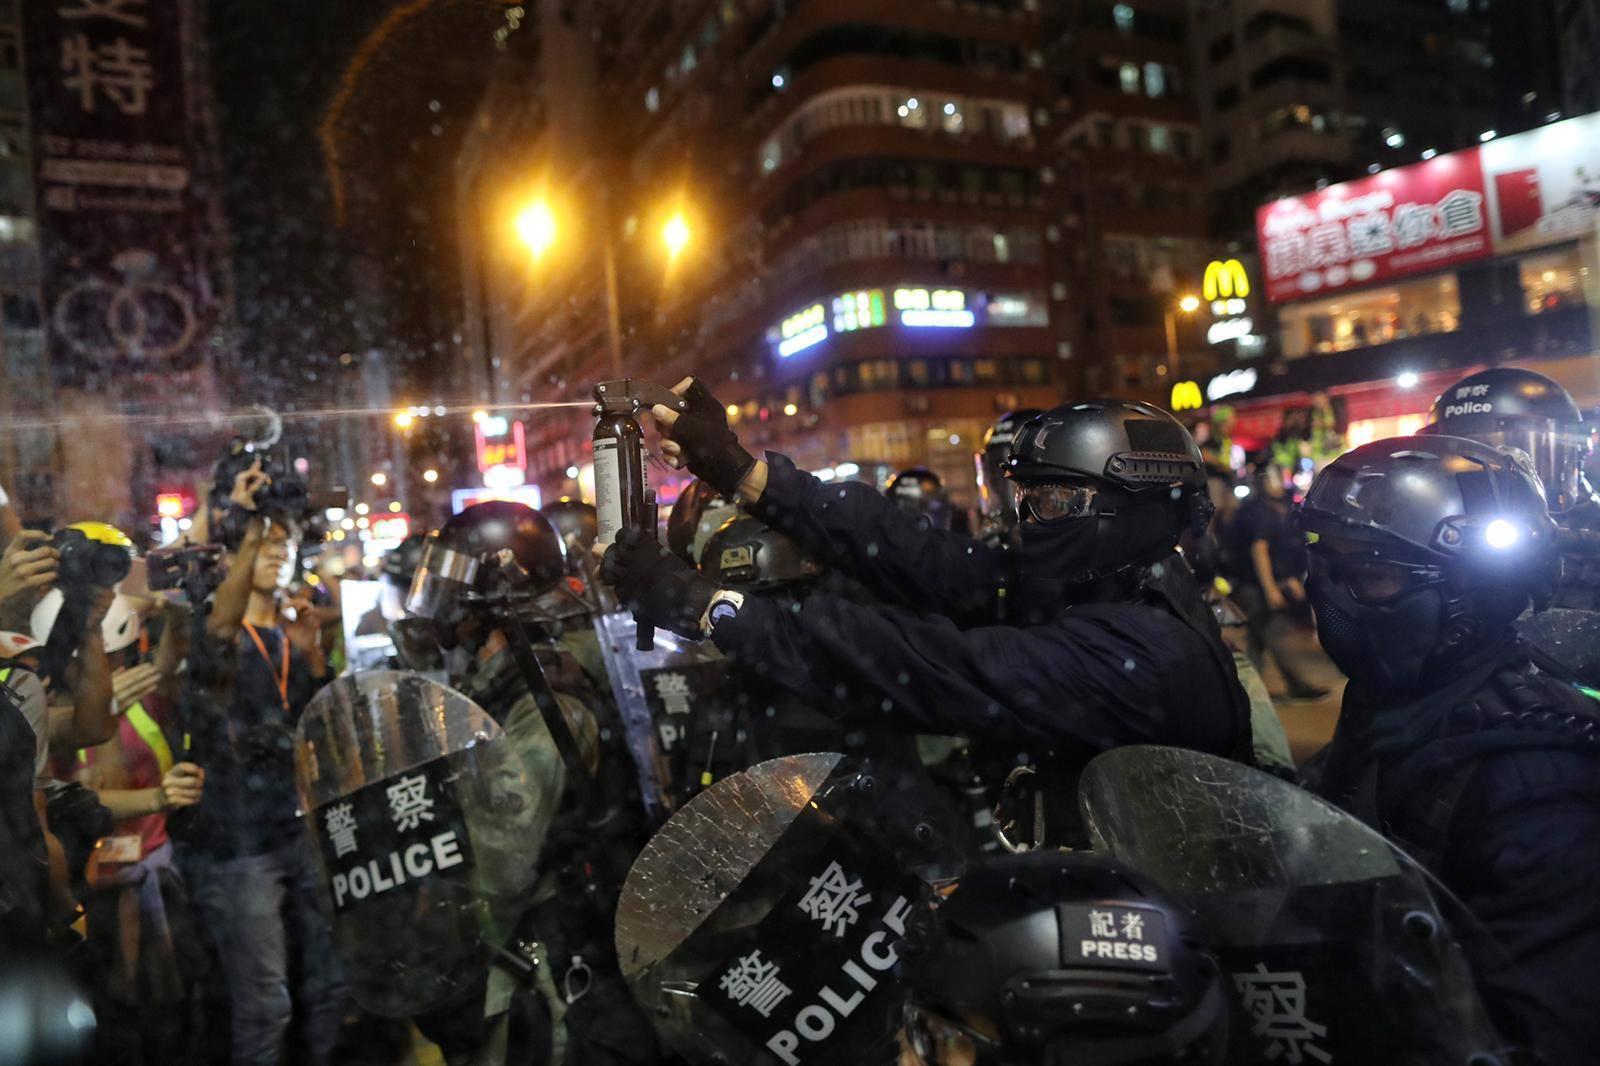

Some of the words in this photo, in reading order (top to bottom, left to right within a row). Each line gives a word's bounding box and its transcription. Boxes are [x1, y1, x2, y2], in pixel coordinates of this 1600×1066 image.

[1445, 401, 1492, 418] Police
[325, 774, 435, 859] 警察
[332, 830, 464, 907] POLICE
[718, 860, 872, 1018] 警察
[1081, 940, 1158, 962] PRESS
[1088, 909, 1145, 940] 記者
[1231, 962, 1333, 1065] 察
